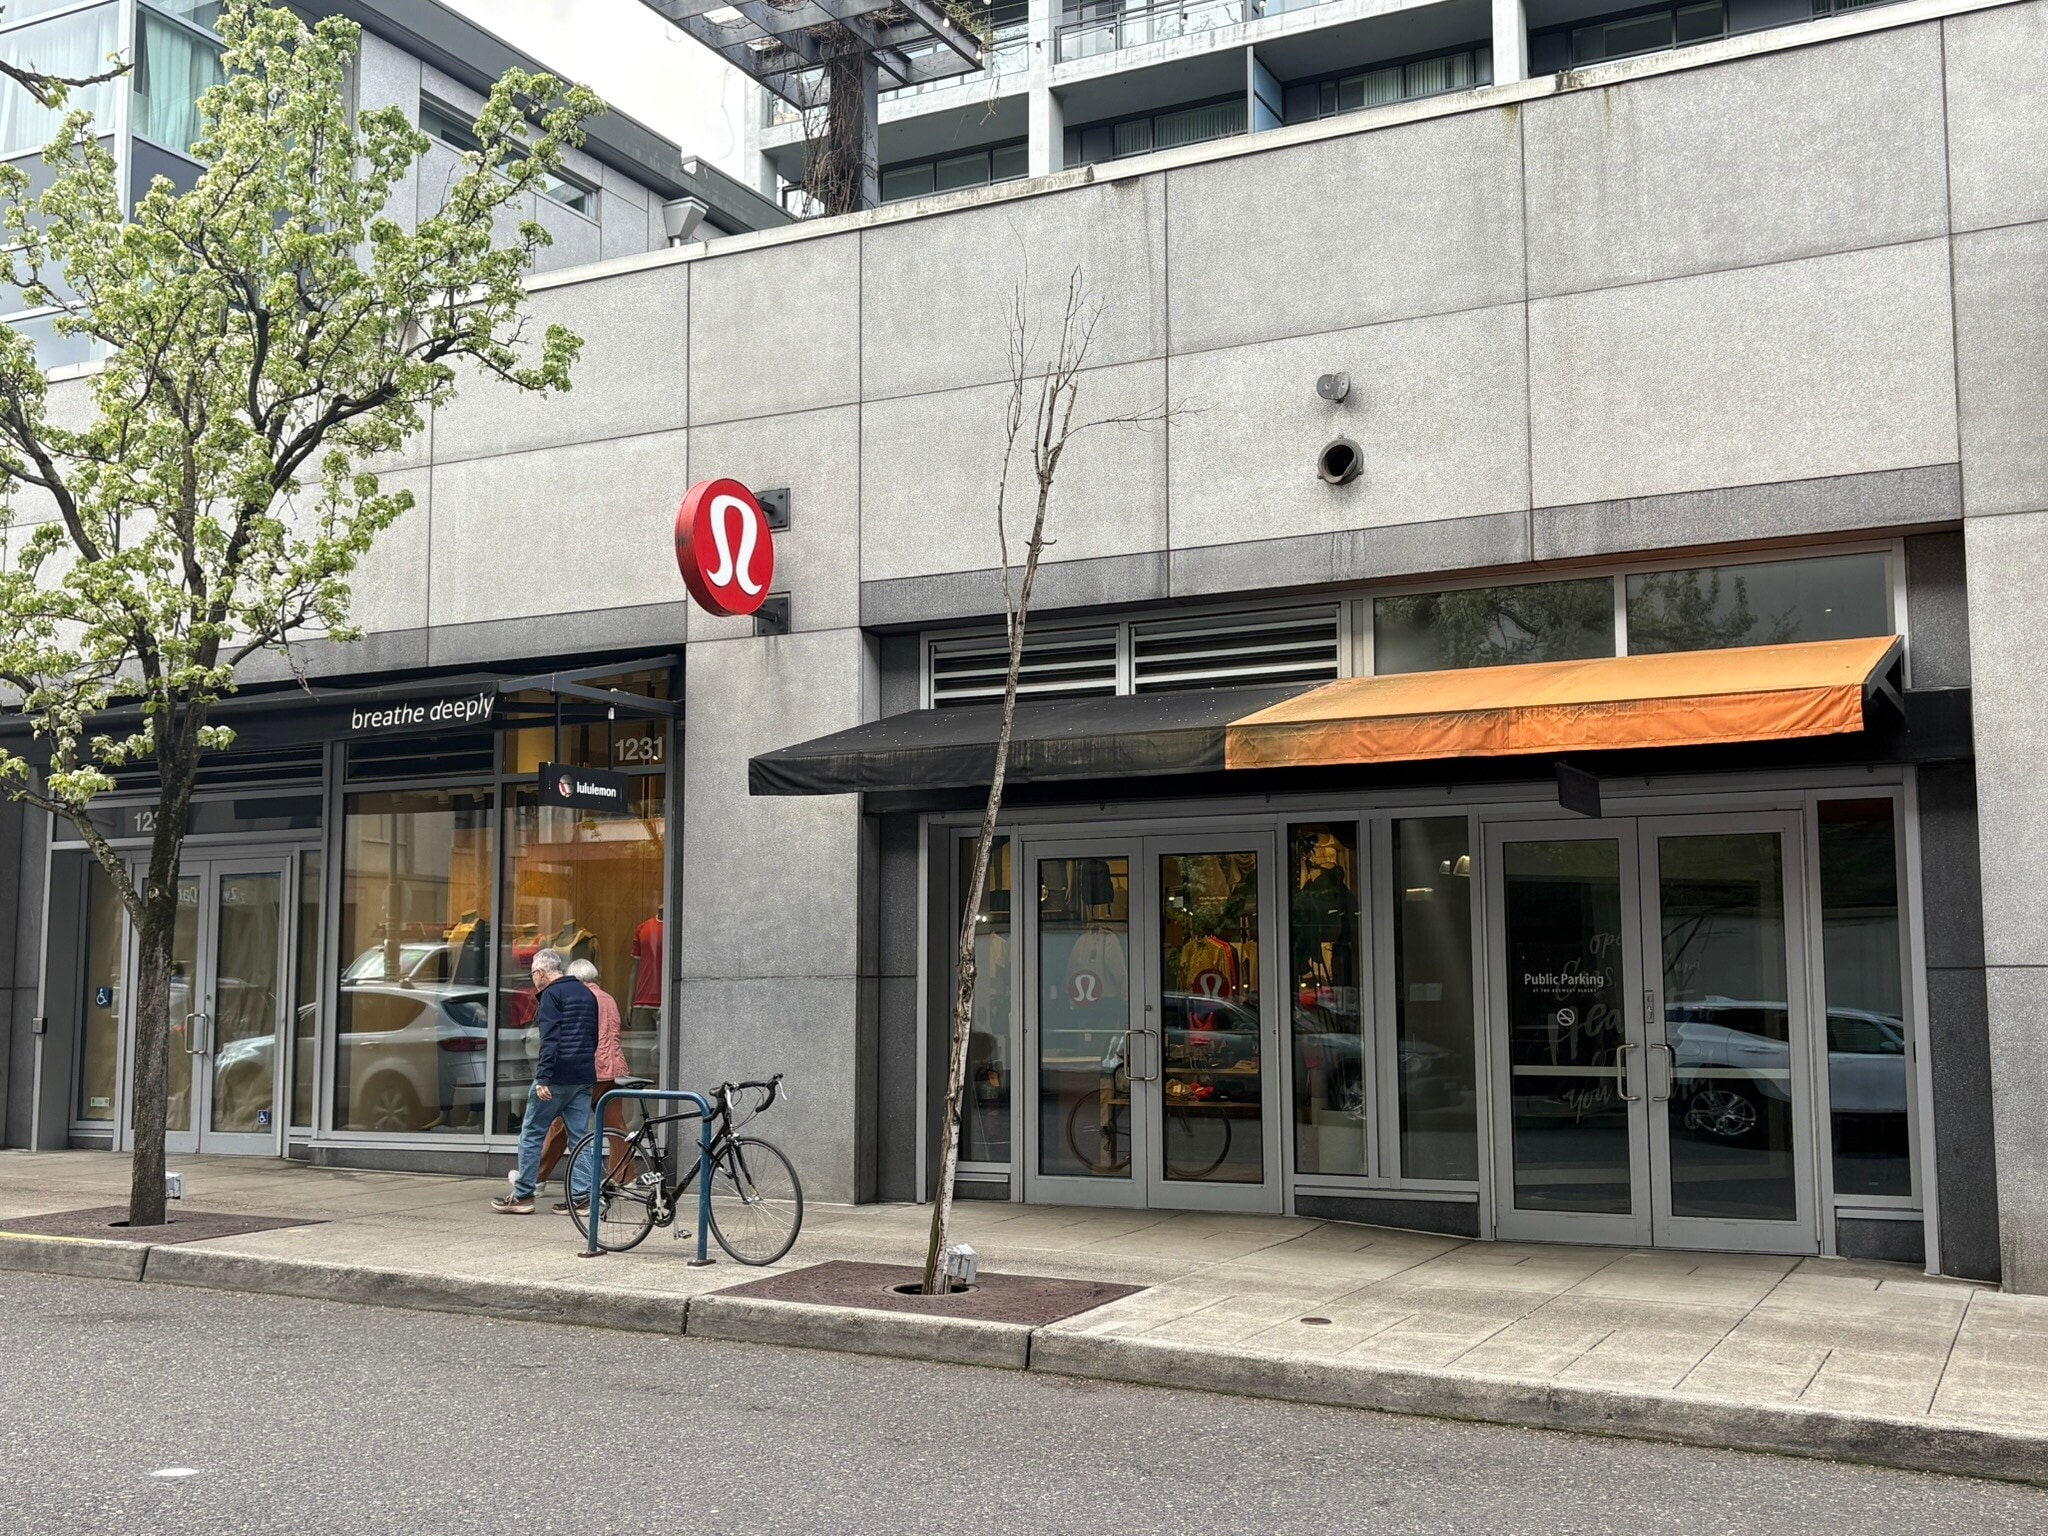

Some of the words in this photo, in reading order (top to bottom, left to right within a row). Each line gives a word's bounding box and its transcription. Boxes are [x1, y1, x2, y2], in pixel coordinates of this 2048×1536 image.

[352, 702, 425, 730] breathe
[430, 692, 495, 721] deeply
[615, 736, 664, 761] 1231
[576, 780, 617, 799] lululemon
[1524, 973, 1558, 985] Public
[1561, 973, 1604, 988] Parking
